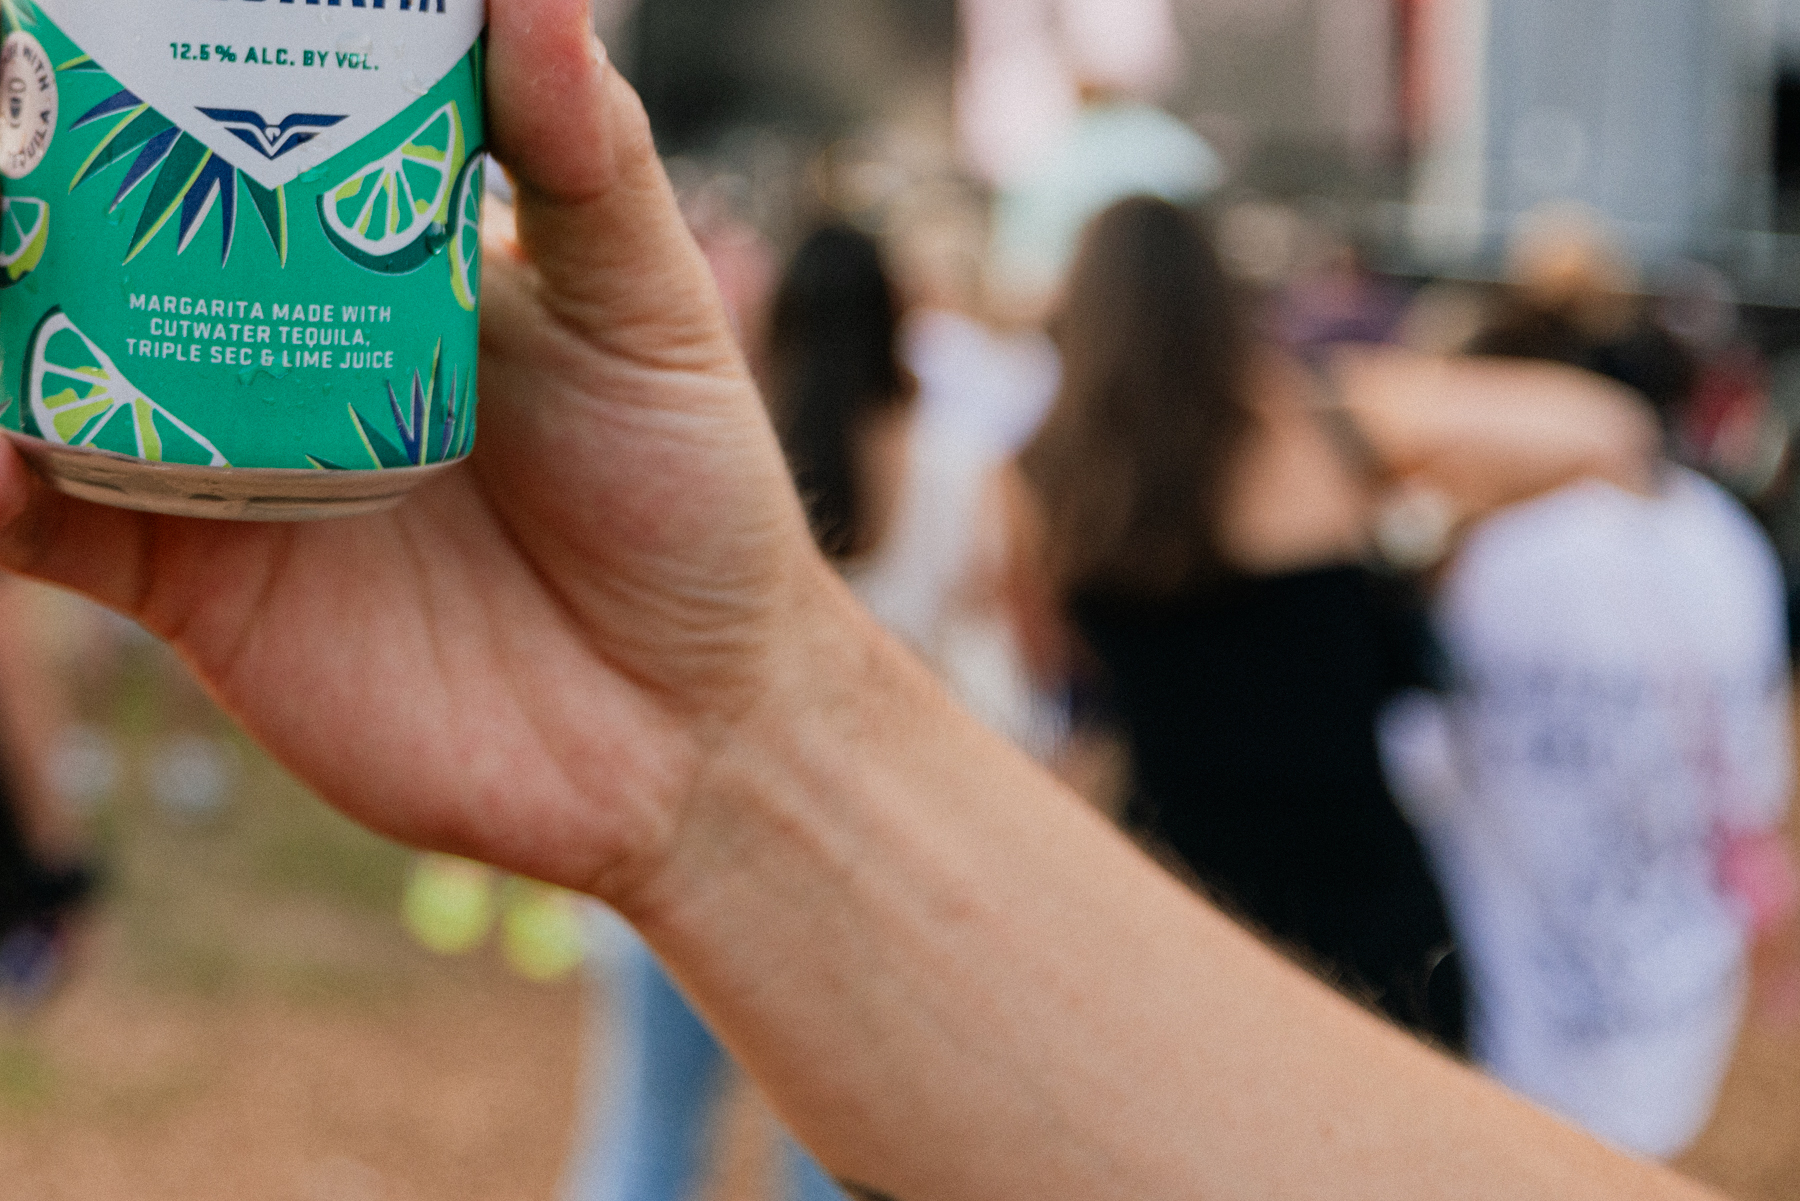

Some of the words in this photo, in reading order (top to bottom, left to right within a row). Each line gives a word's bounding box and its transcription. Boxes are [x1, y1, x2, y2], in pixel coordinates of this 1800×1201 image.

[244, 46, 296, 67] ALC.
[302, 49, 329, 68] BY
[335, 50, 380, 72] VOL.
[128, 292, 265, 320] MARGARITA
[272, 302, 335, 323] MADE
[341, 304, 392, 323] WITH
[150, 317, 271, 344] CUTWATER
[279, 325, 371, 348] TEQUILA,
[125, 337, 202, 363] TRIPLE
[210, 345, 253, 366] SEC
[259, 348, 275, 367] &
[281, 350, 333, 369] LIME
[339, 350, 394, 369] JUICE
